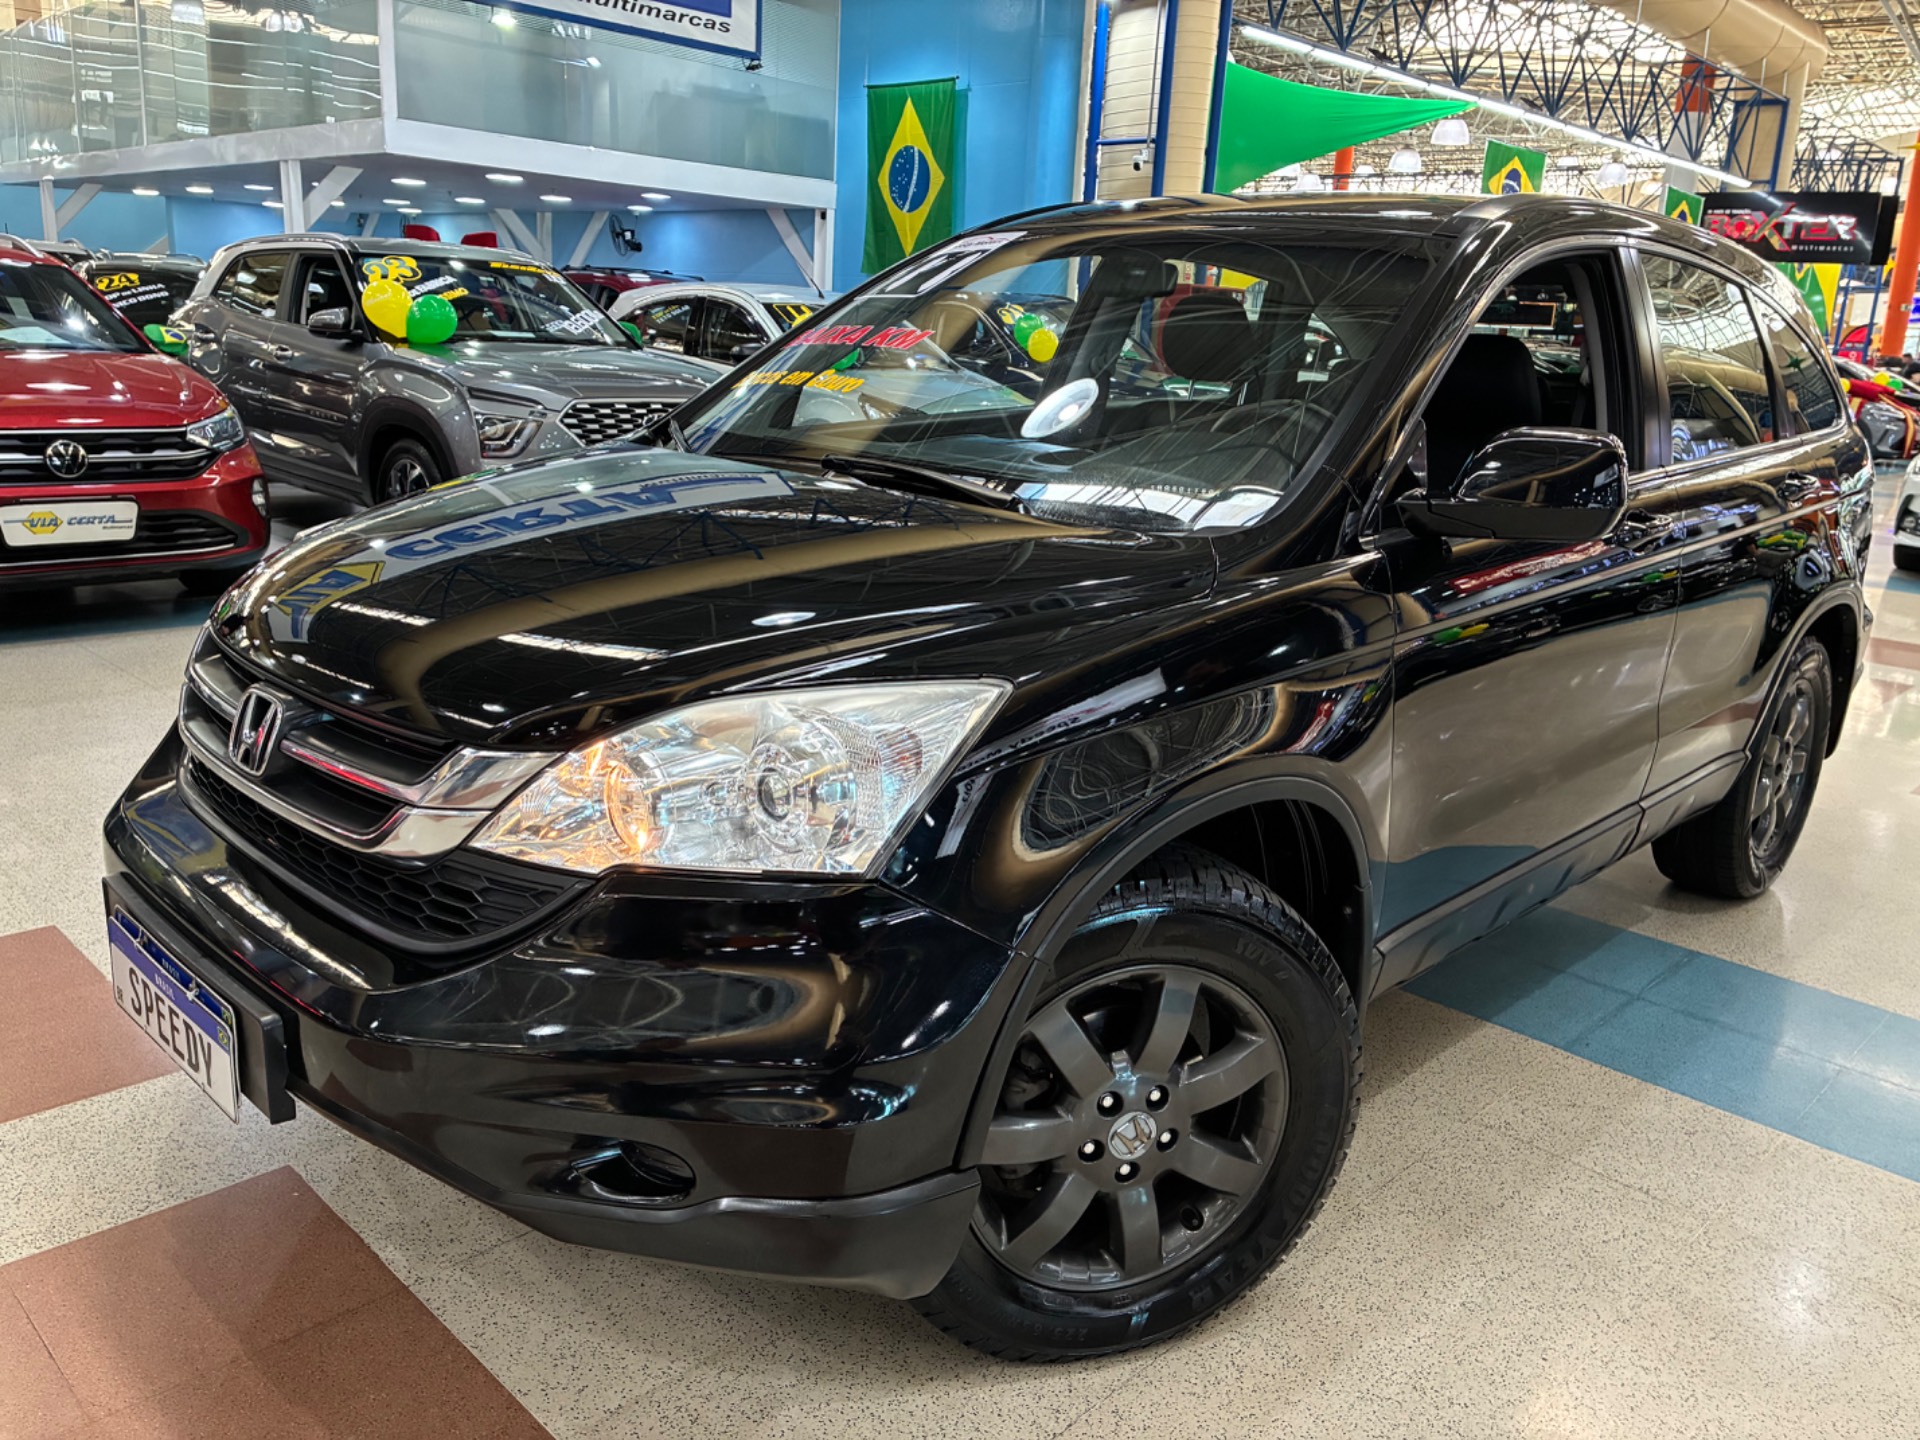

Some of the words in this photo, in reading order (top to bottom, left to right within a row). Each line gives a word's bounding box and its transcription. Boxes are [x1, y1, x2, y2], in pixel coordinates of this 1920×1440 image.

[577, 0, 732, 33] ultimarcas
[1704, 202, 1857, 252] BOXTER
[95, 272, 141, 291] 24
[112, 298, 138, 308] NICO
[862, 326, 936, 350] KM
[807, 368, 866, 393] Couro
[27, 517, 60, 528] VIA
[66, 514, 117, 526] CERTA
[128, 967, 213, 1089] SPEEDY
